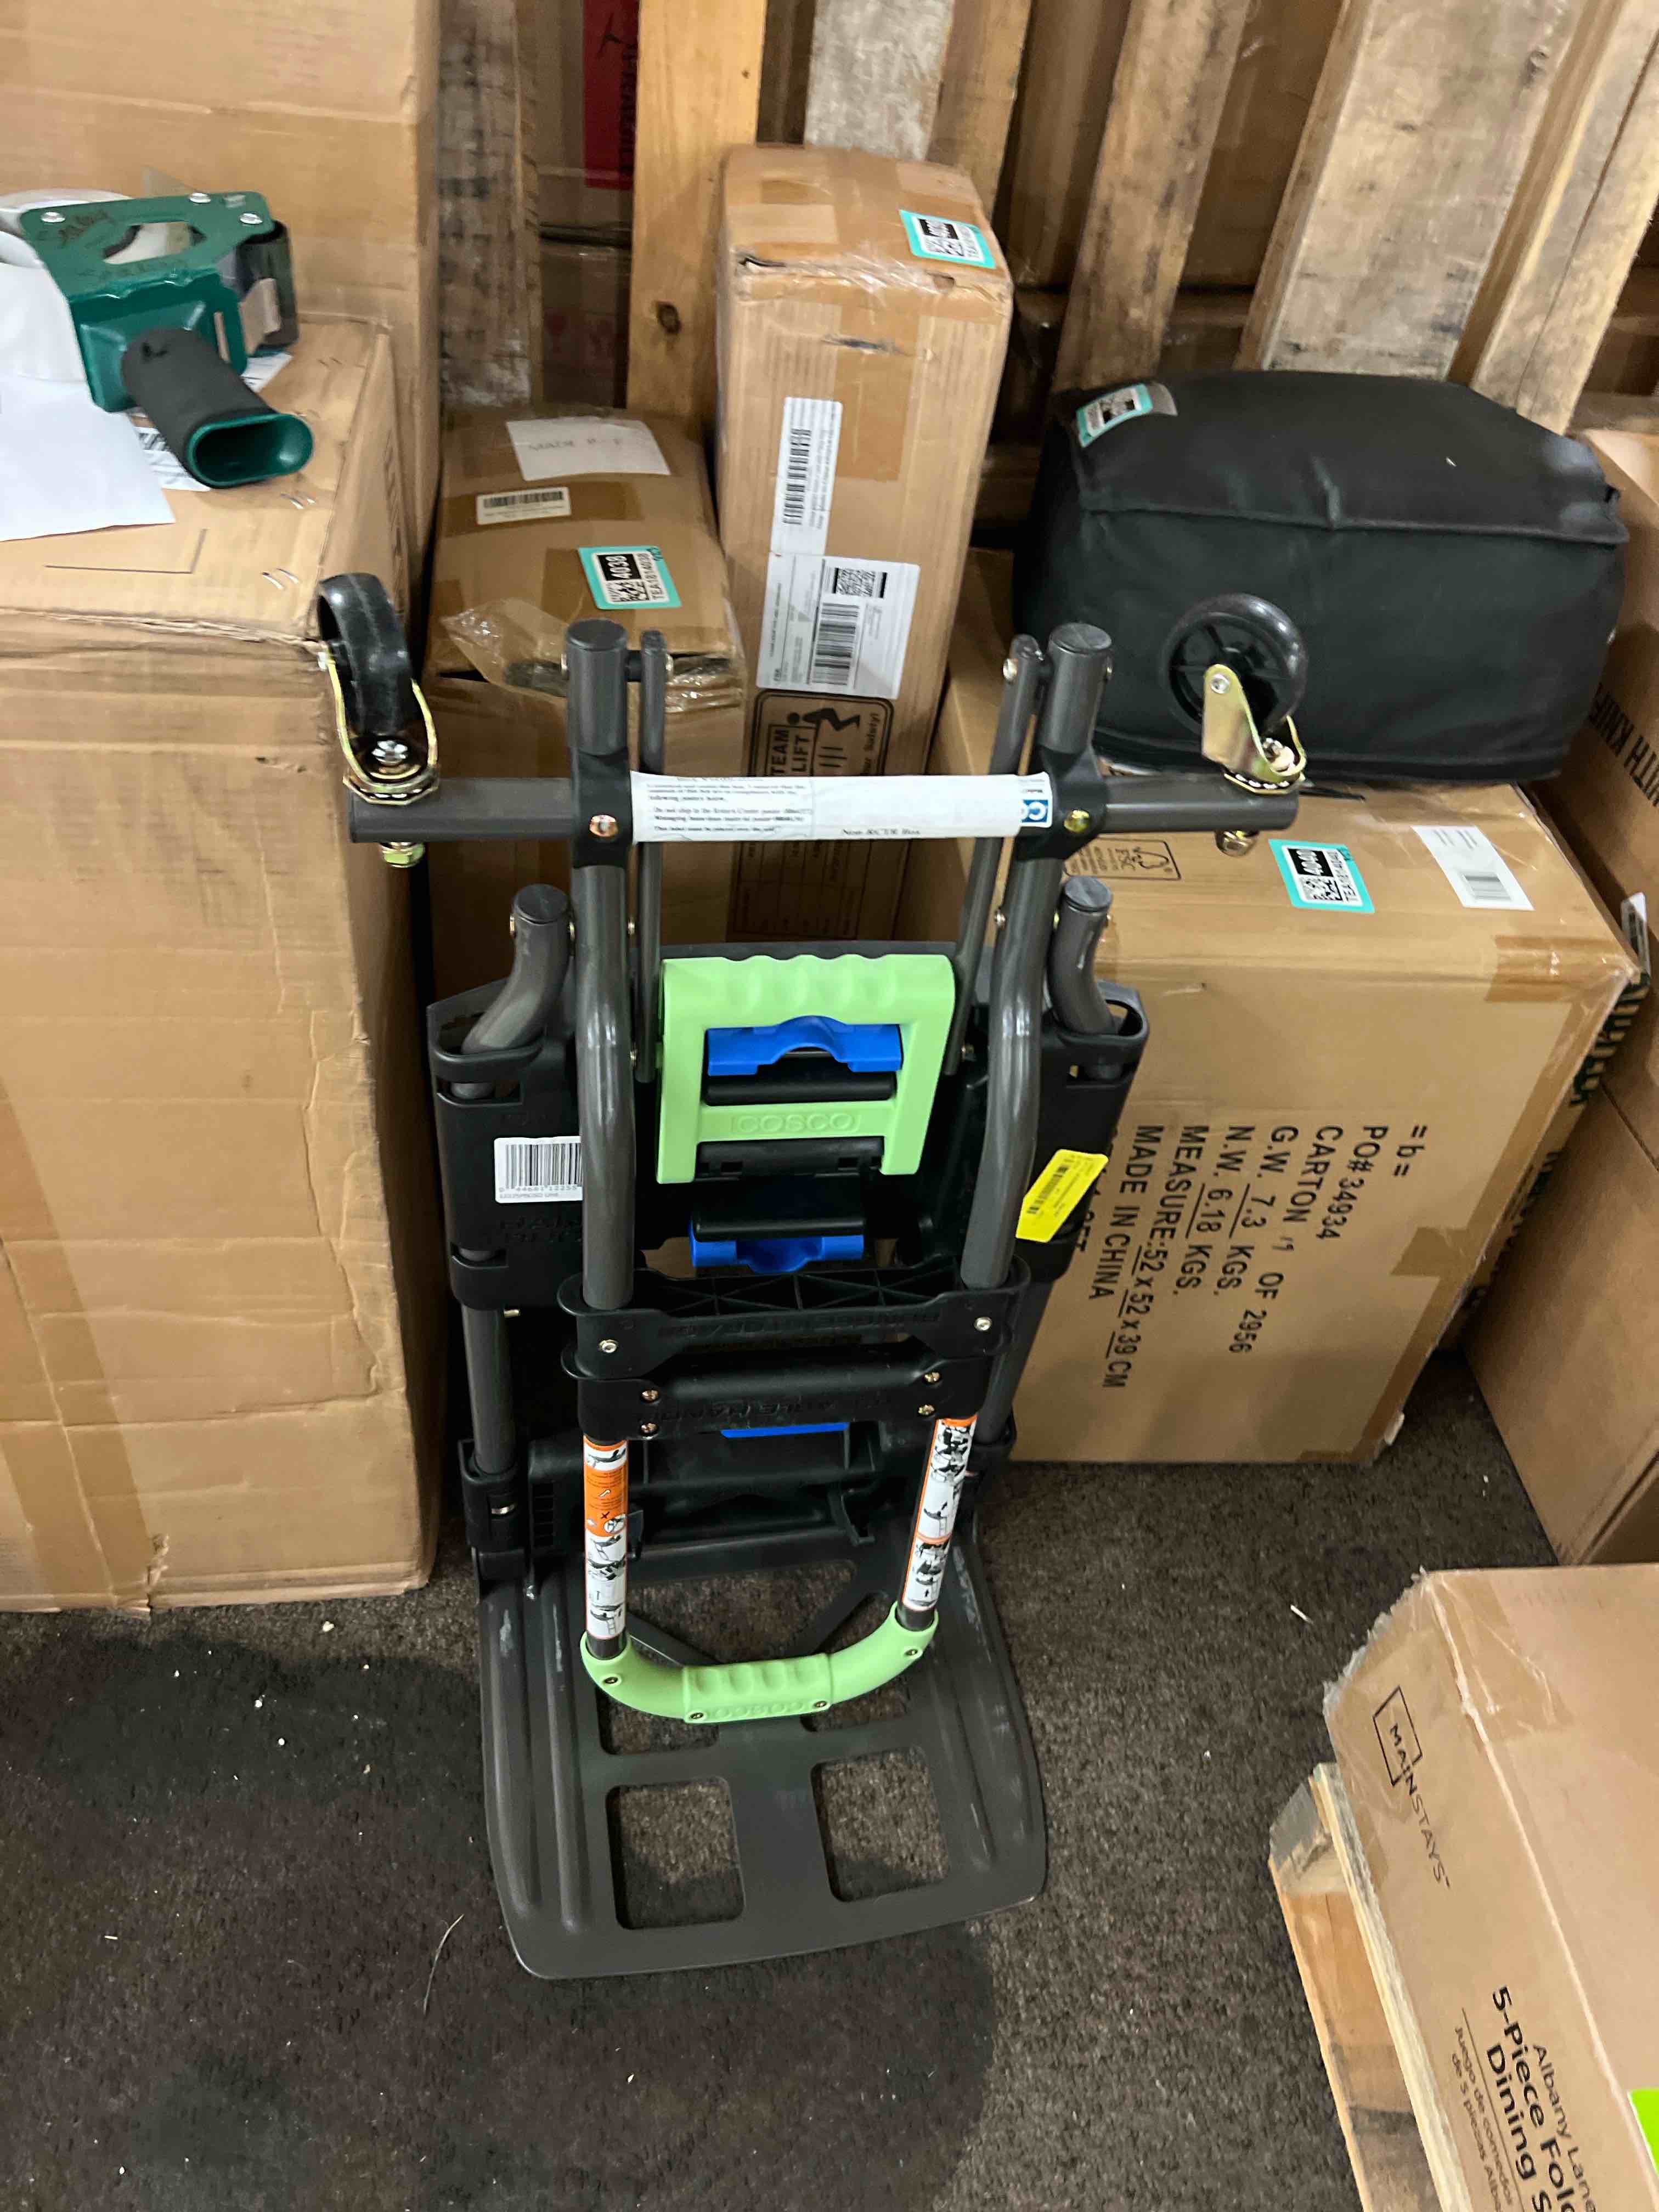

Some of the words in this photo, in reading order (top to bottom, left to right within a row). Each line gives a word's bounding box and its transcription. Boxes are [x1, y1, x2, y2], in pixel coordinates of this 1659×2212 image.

[605, 555, 632, 579] 4038
[770, 729, 789, 776] TEAM
[791, 735, 810, 772] LIFT
[737, 1113, 854, 1133] COSCO
[1119, 1125, 1165, 1194] MADE
[1213, 1125, 1256, 1177] N.W.
[1256, 1125, 1299, 1178] G.W.
[1282, 1125, 1344, 1222] CARTON
[1109, 1205, 1141, 1227] IN
[1196, 1188, 1233, 1232] 6.18
[1240, 1196, 1276, 1228] 7.3
[1088, 1233, 1131, 1300] CHINA
[1173, 1244, 1214, 1295] KGS.
[1213, 1245, 1255, 1296] KGS.
[1255, 1272, 1284, 1300] OF
[1126, 1293, 1154, 1315] 52
[1114, 1334, 1142, 1355] 39
[1228, 1309, 1267, 1353] 2956
[1102, 1361, 1132, 1387] CM
[1390, 1722, 1446, 1884] MAINSTAYS
[1492, 1986, 1545, 2129] 5-Piece
[1452, 2052, 1463, 2079] de
[1463, 2101, 1486, 2162] piezas
[1486, 2042, 1537, 2181] Dining
[1533, 2044, 1572, 2140] Albany
[1474, 2089, 1485, 2114] de
[1483, 2118, 1513, 2206] comedor
